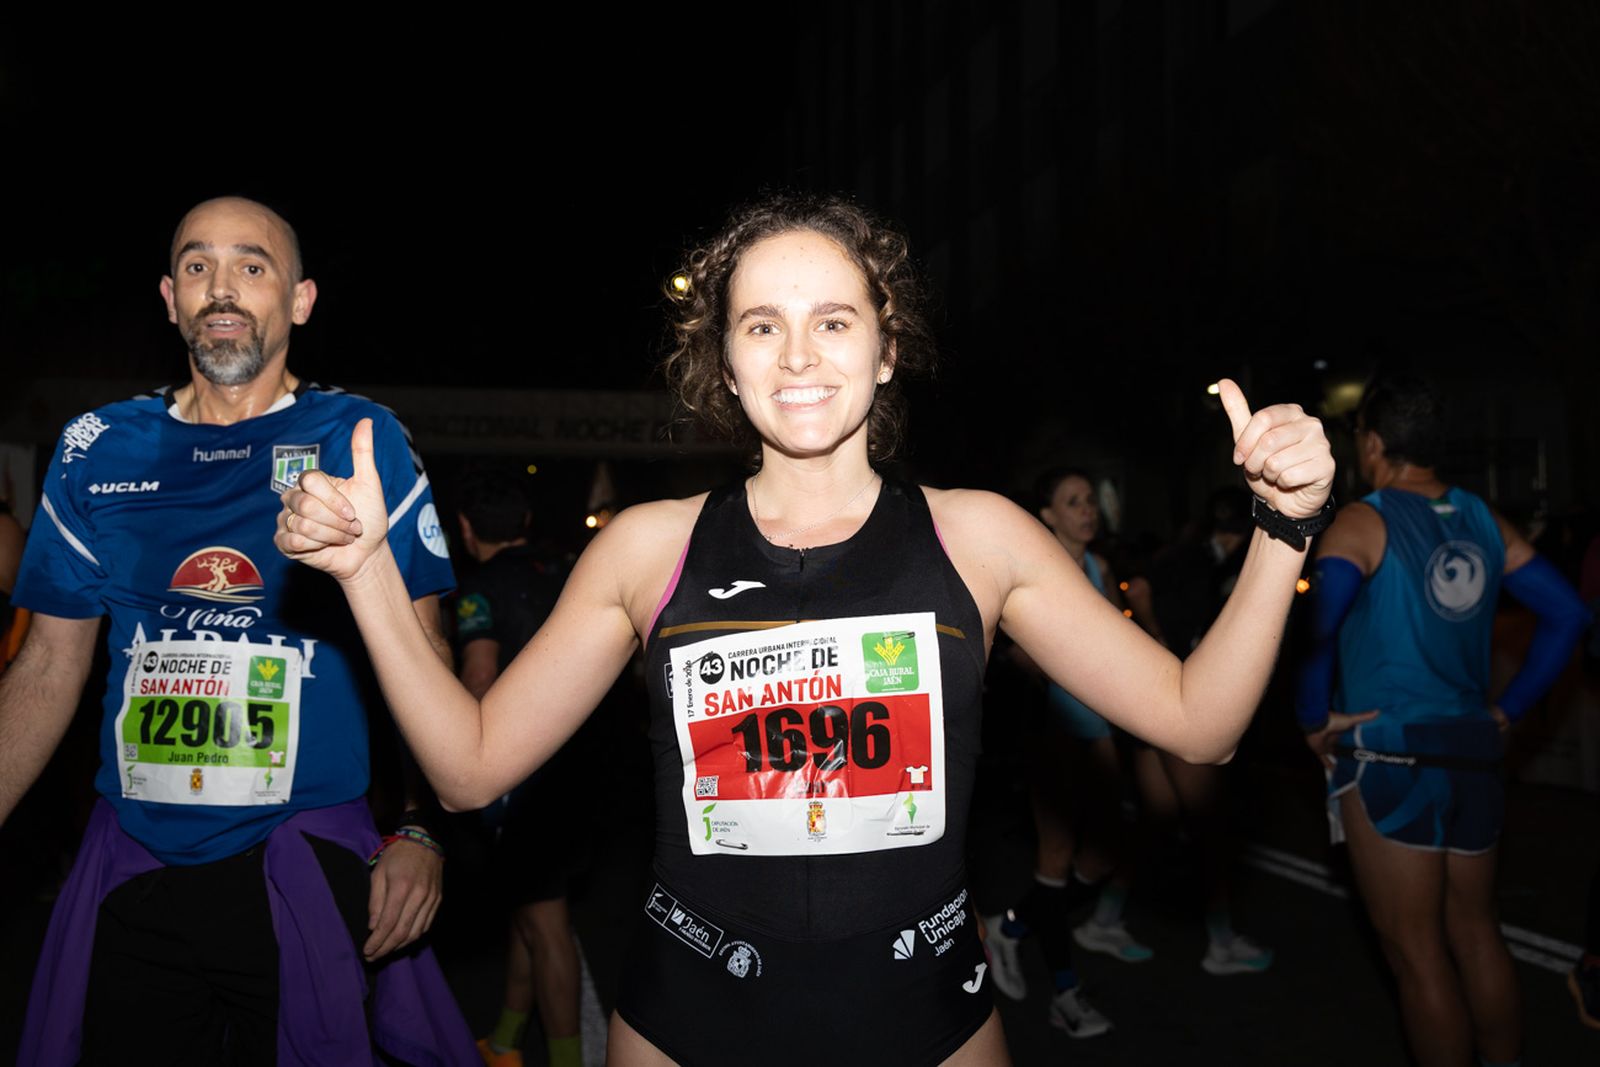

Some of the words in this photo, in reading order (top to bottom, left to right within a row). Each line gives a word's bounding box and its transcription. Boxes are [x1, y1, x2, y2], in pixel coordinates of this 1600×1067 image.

[193, 445, 251, 462] hummel
[101, 481, 160, 494] UCLM
[728, 648, 757, 659] CARRERA
[759, 643, 785, 654] URBANA
[786, 636, 837, 650] INTERCIONAL
[159, 659, 207, 674] NOCHE
[211, 660, 232, 675] DE
[700, 658, 723, 676] 43
[730, 650, 806, 681] NOCHE
[811, 646, 839, 669] DE
[140, 678, 169, 695] SAN
[170, 675, 231, 697] ANTÓN
[704, 686, 753, 716] SAN
[760, 670, 842, 705] ANTÓN
[686, 687, 694, 708] Enero
[139, 698, 275, 749] 12905
[732, 701, 891, 773] 1696
[168, 751, 193, 763] Juan
[196, 751, 229, 764] Pedro
[683, 916, 710, 942] Jaén
[924, 909, 967, 944] Unicaja
[934, 938, 955, 957] Jaén
